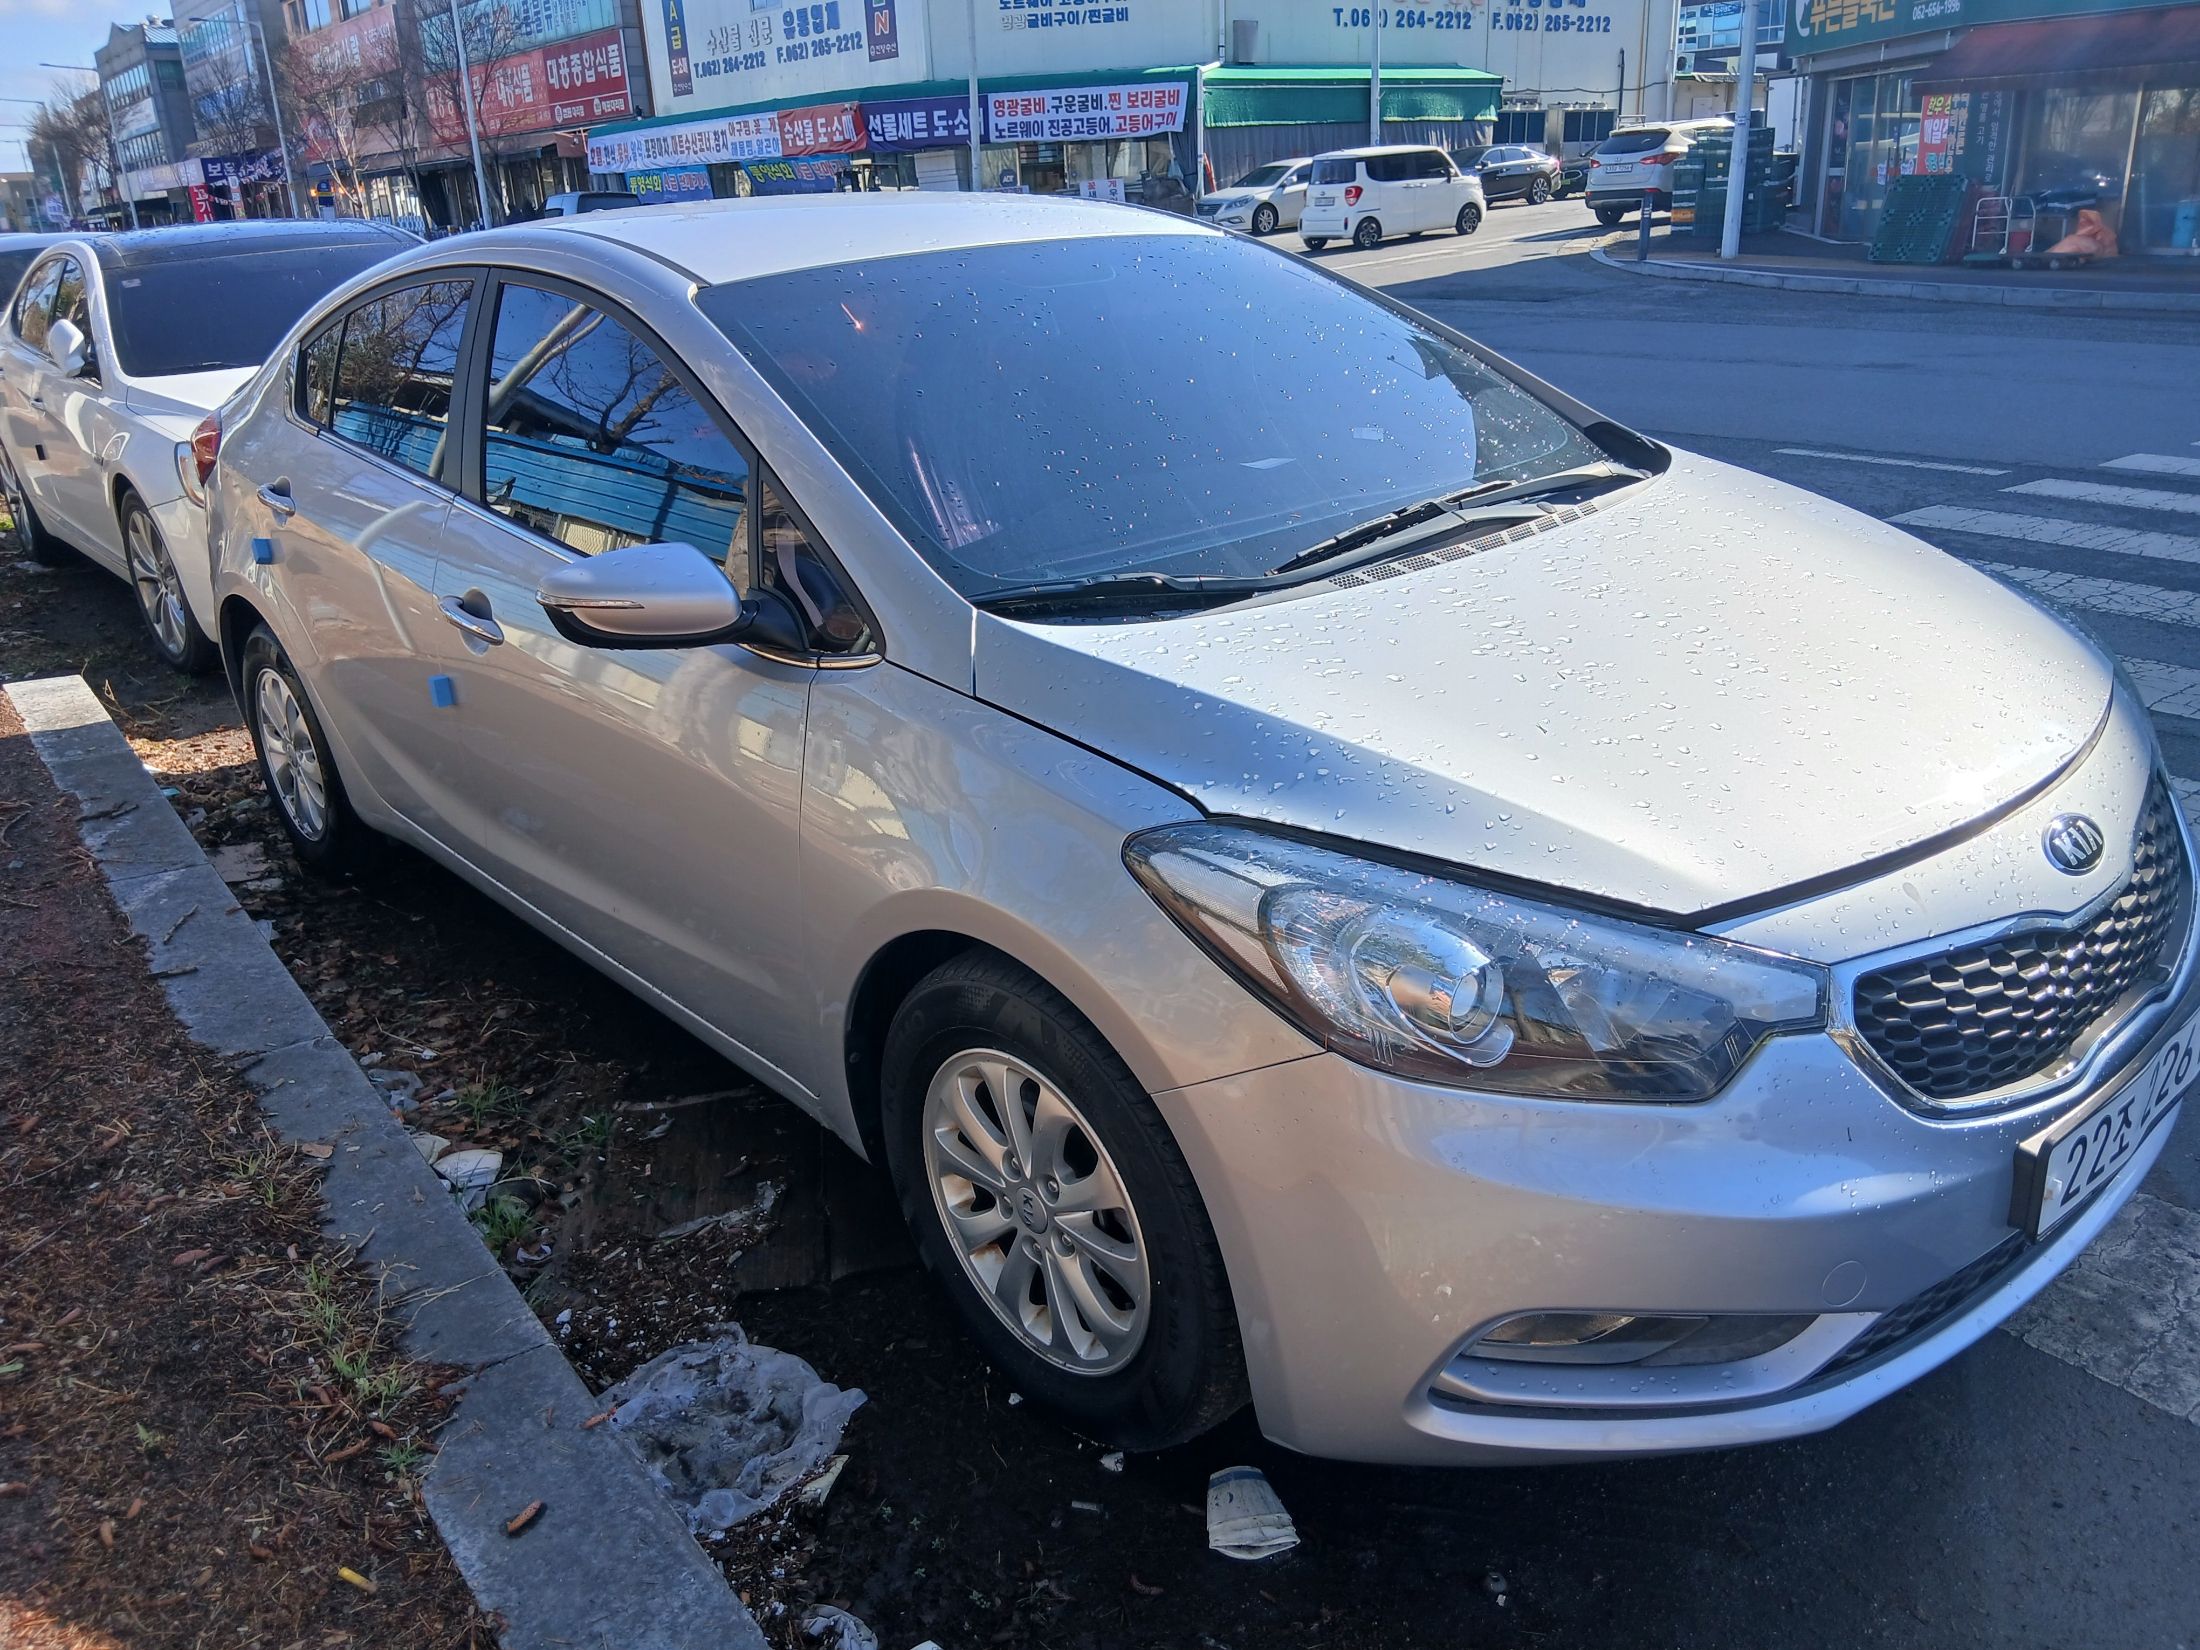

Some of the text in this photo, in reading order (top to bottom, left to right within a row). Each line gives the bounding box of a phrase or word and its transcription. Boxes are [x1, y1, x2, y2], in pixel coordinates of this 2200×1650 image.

[1333, 8, 1472, 30] T.06) 264-2212
[1492, 12, 1611, 33] F.062) 265-2212
[776, 31, 863, 64] F.062) 265-2212
[546, 43, 622, 90] 대흥종합식품
[694, 51, 766, 78] T.062) 264-2212
[1127, 89, 1180, 109] 보리굴비
[784, 119, 814, 149] 수산물
[868, 109, 928, 143] 선물세트
[994, 119, 1044, 139] 노르웨이
[2054, 818, 2102, 866] KIA
[2060, 1023, 2200, 1207] 22조 226
